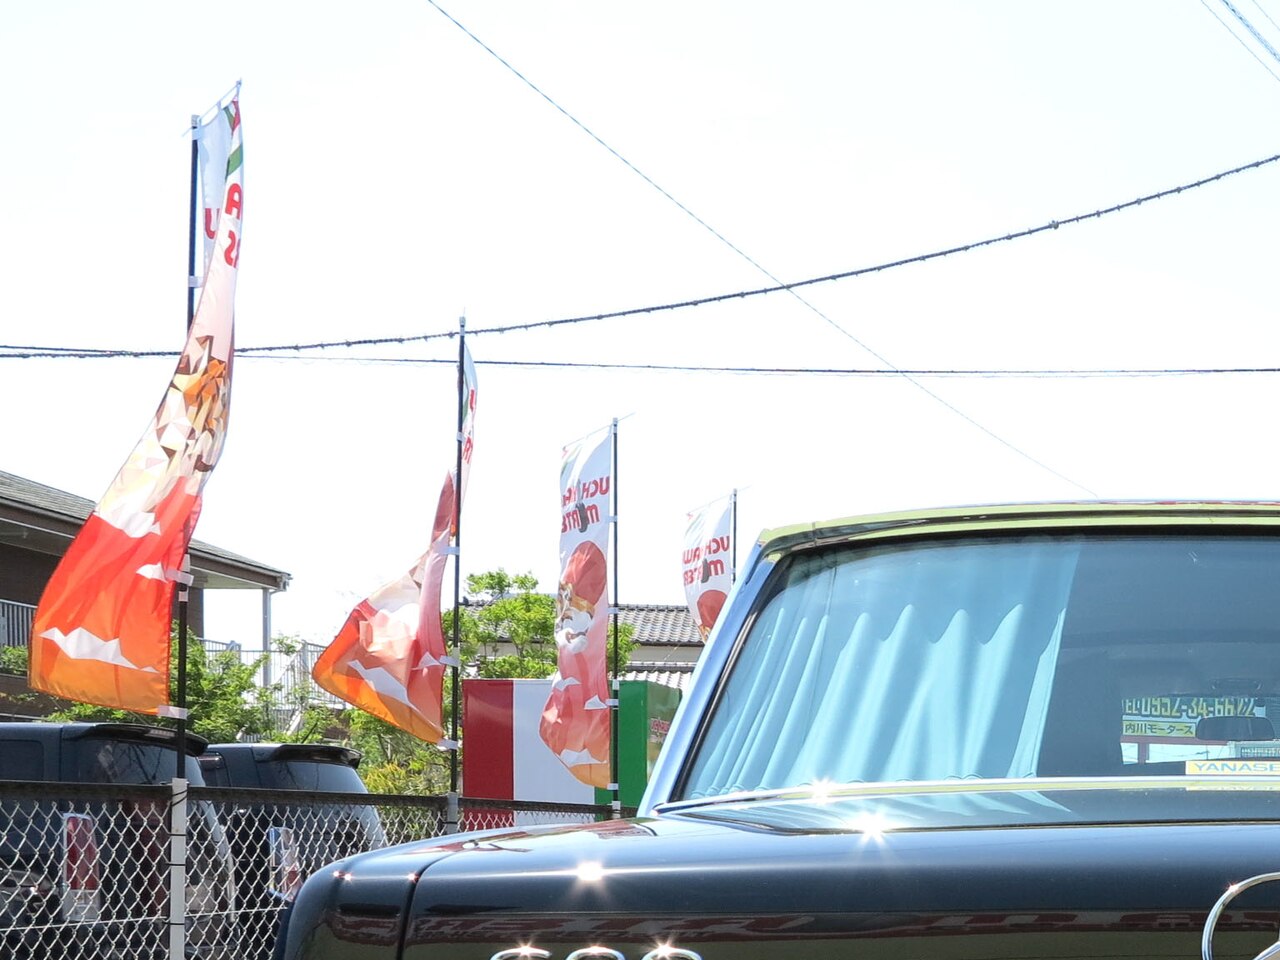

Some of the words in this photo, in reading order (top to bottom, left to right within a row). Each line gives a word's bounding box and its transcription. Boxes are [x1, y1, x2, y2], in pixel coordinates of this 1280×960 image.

[1124, 721, 1194, 735] 内川モータース
